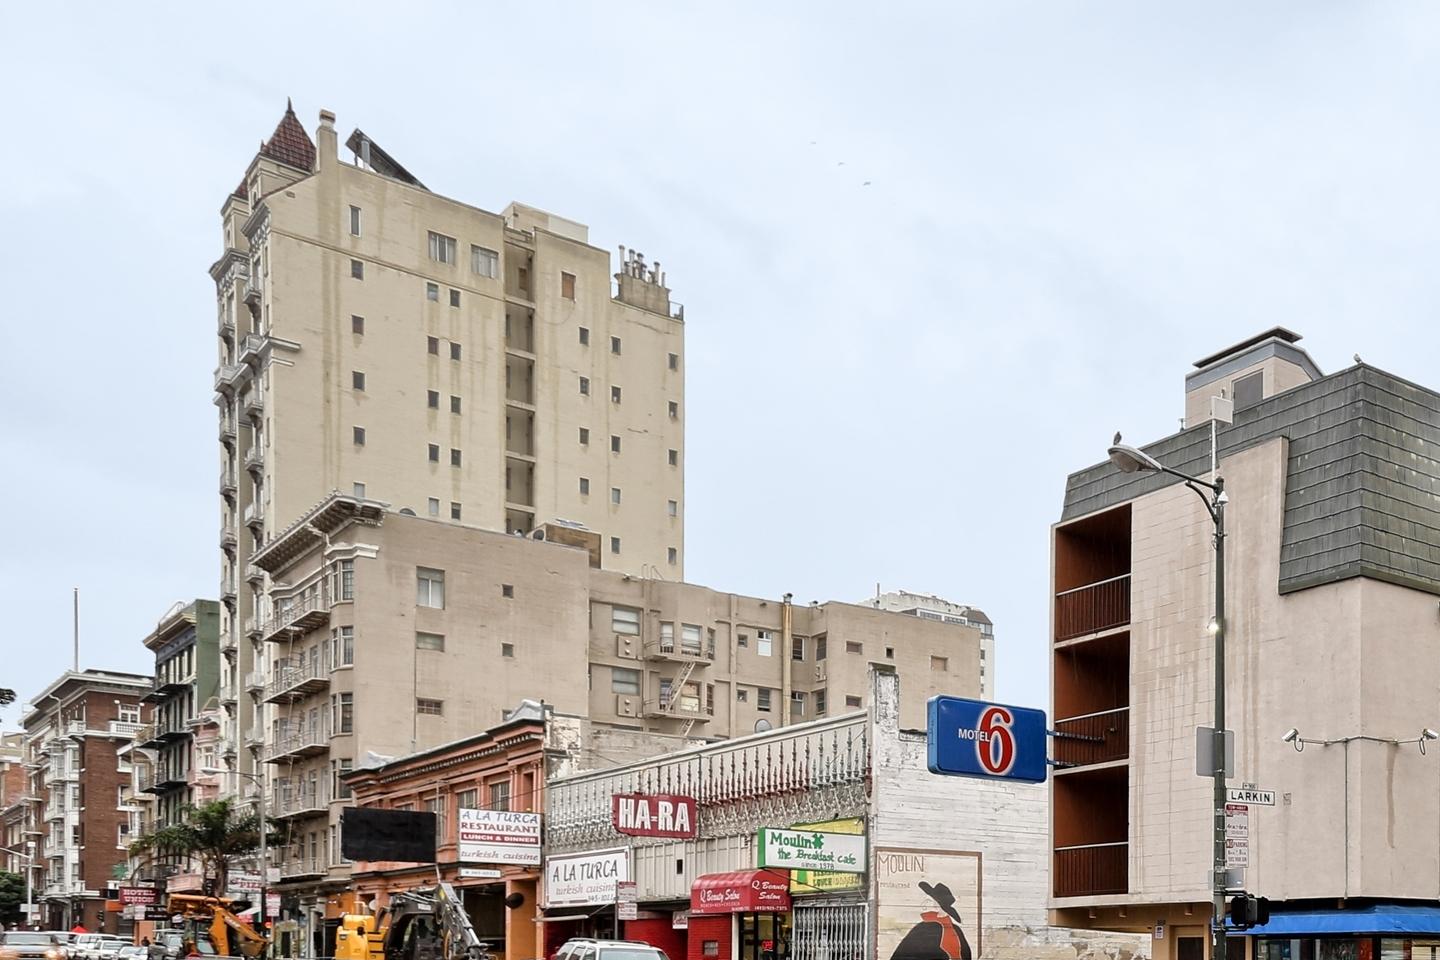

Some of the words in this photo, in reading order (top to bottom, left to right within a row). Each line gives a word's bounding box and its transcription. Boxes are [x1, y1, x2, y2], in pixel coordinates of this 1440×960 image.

[958, 728, 990, 742] MOTEL
[977, 706, 1016, 775] 6
[1231, 791, 1270, 802] LARKIN
[463, 811, 470, 819] A
[476, 811, 490, 820] LA
[496, 812, 538, 824] TURCA
[619, 798, 690, 832] HA-RA
[461, 822, 538, 833] RESTAURANT
[770, 832, 812, 848] Moulin
[461, 850, 499, 859] turkish
[503, 853, 538, 861] cuisine
[778, 848, 791, 859] the
[796, 849, 834, 862] Breakfast
[838, 854, 856, 865] cafe
[553, 867, 559, 882] A
[564, 864, 576, 881] LA
[580, 860, 618, 880] TURCA
[878, 854, 924, 877] MOULIN
[752, 881, 760, 889] Q
[762, 882, 788, 891] Beauty
[700, 889, 706, 902] Q
[706, 890, 724, 902] Beauty
[725, 889, 740, 900] Salon
